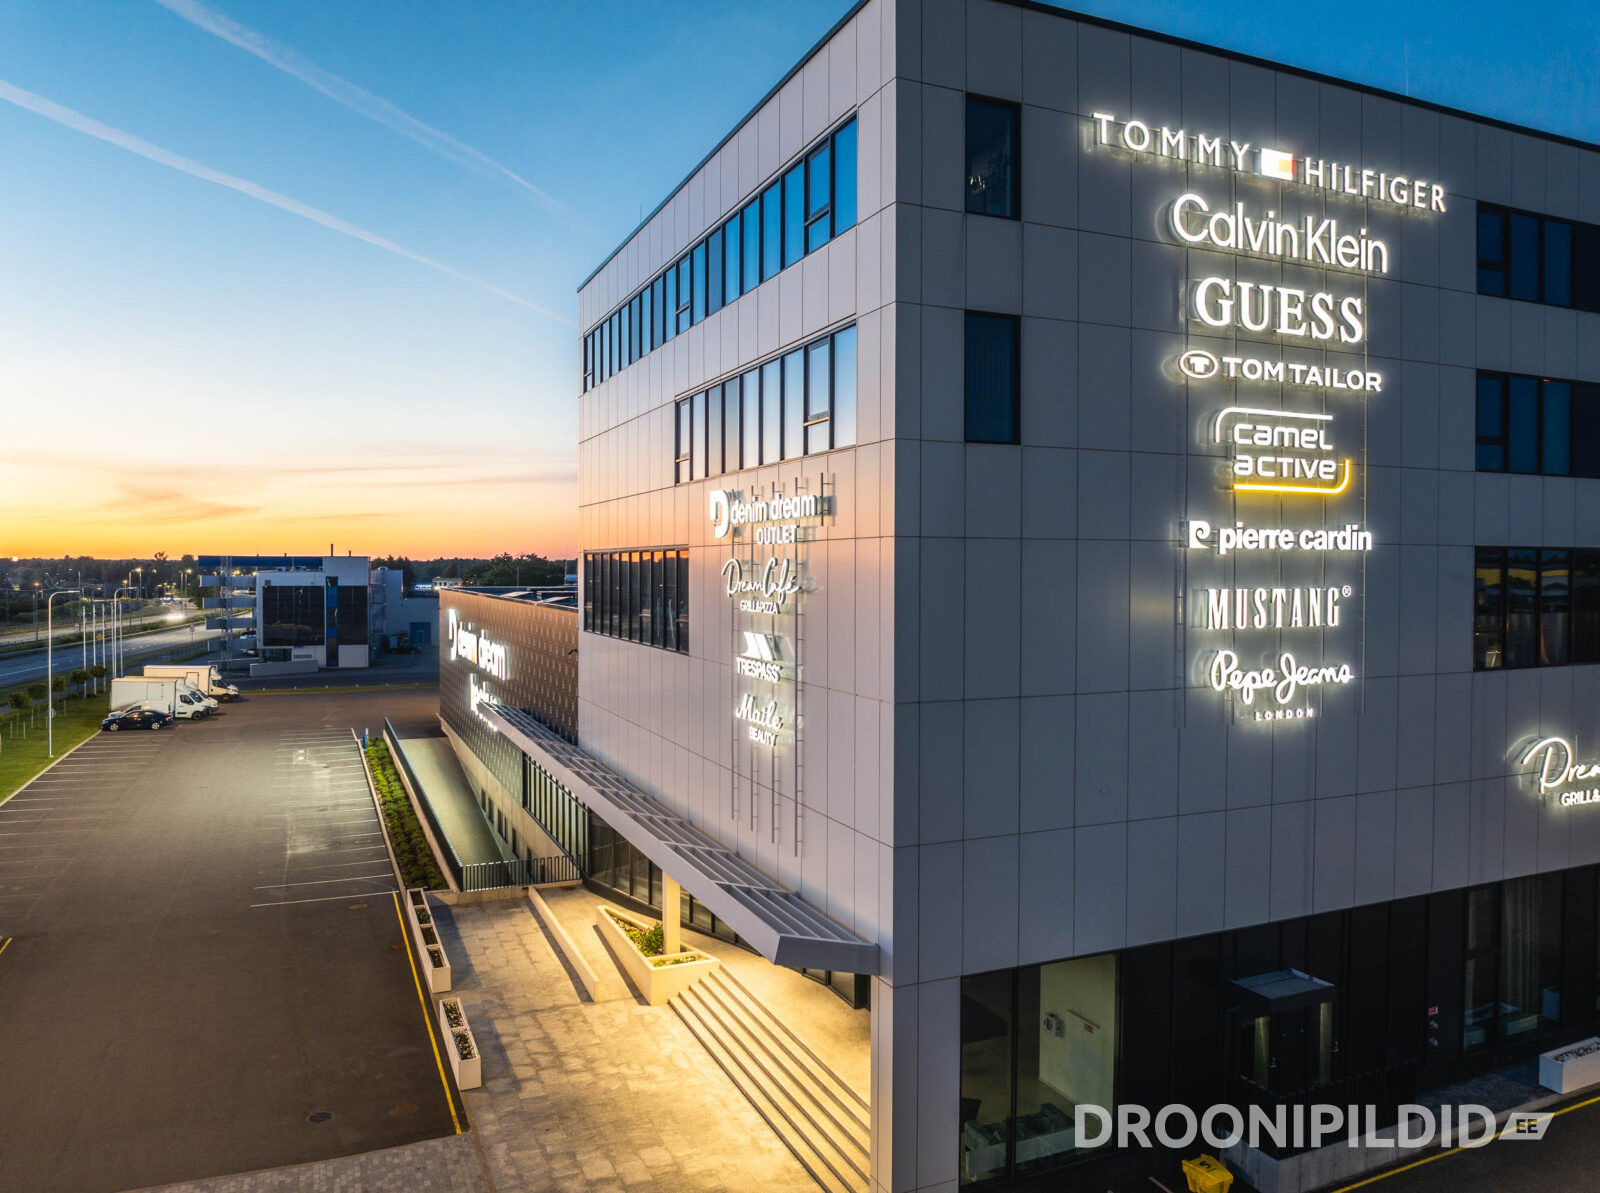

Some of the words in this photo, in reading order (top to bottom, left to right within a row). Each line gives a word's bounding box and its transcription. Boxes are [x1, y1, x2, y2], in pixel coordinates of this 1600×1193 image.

[1093, 112, 1250, 172] TOMMY
[1305, 157, 1447, 213] HILFIGER
[1172, 193, 1298, 259] Calvin
[1306, 216, 1389, 274] Klein
[1195, 276, 1363, 344] GUESS
[1222, 356, 1284, 382] TOM
[1289, 363, 1383, 392] TAILOR
[730, 496, 769, 525] denim
[770, 493, 818, 521] dream
[756, 524, 798, 545] OUTLET
[1219, 521, 1294, 555] pierre
[1299, 524, 1373, 551] cardin
[721, 558, 764, 598] Dream
[762, 557, 801, 606] Café
[736, 656, 782, 683] TRESPASS
[1211, 650, 1278, 705] Pepe
[1274, 653, 1354, 704] Jeans
[1255, 707, 1314, 722] LONDON
[749, 726, 777, 747] BEAUTY
